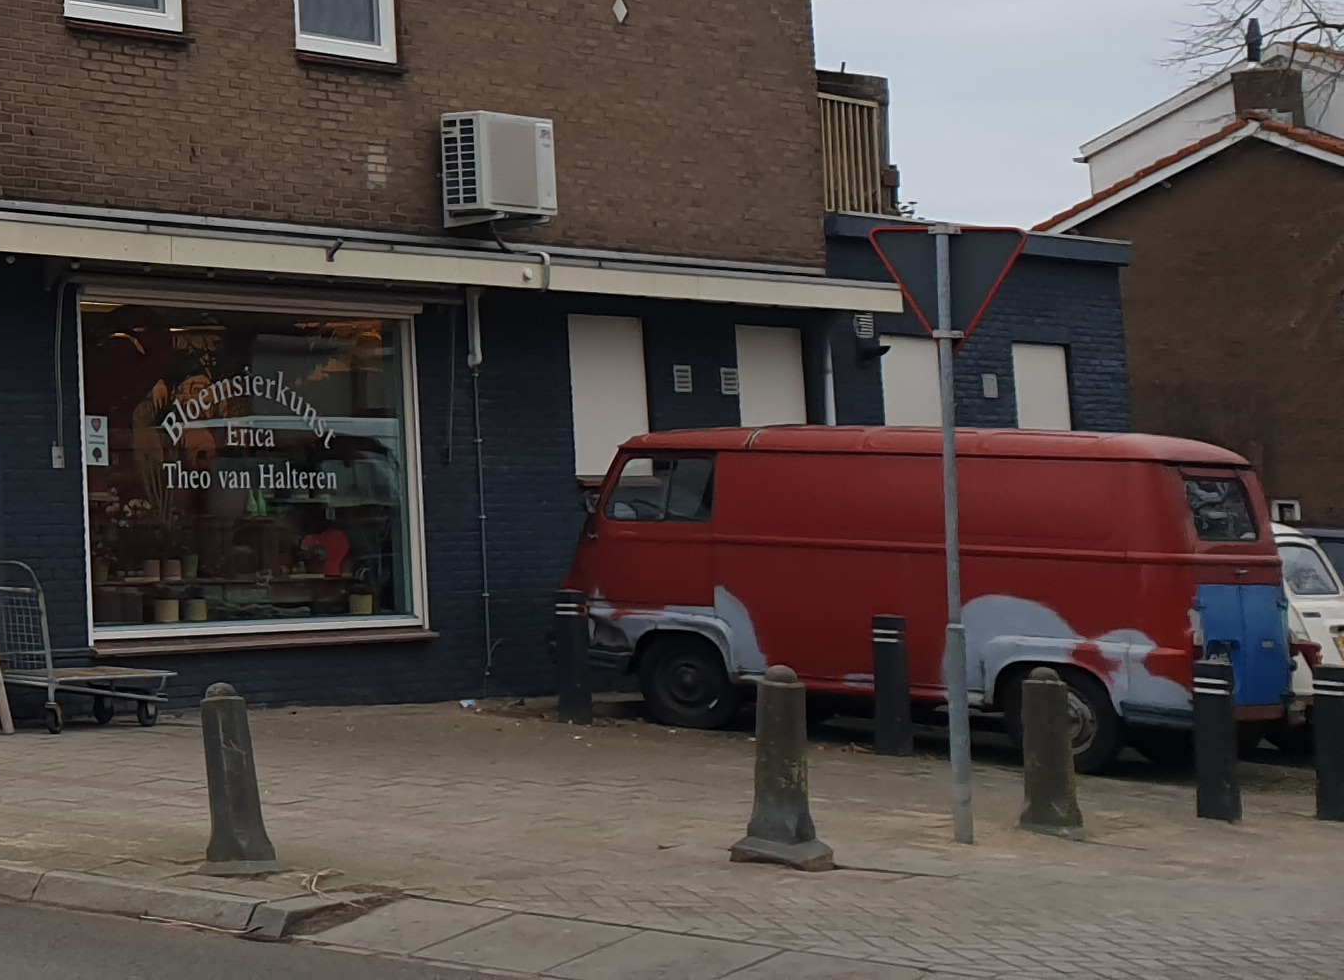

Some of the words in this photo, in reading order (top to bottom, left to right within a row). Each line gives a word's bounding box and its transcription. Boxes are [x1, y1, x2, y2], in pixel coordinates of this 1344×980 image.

[162, 366, 335, 449] Bloemsierkunst
[226, 422, 275, 447] Erica
[162, 460, 211, 489] Theo
[219, 469, 251, 489] van
[258, 461, 338, 490] Halteren
